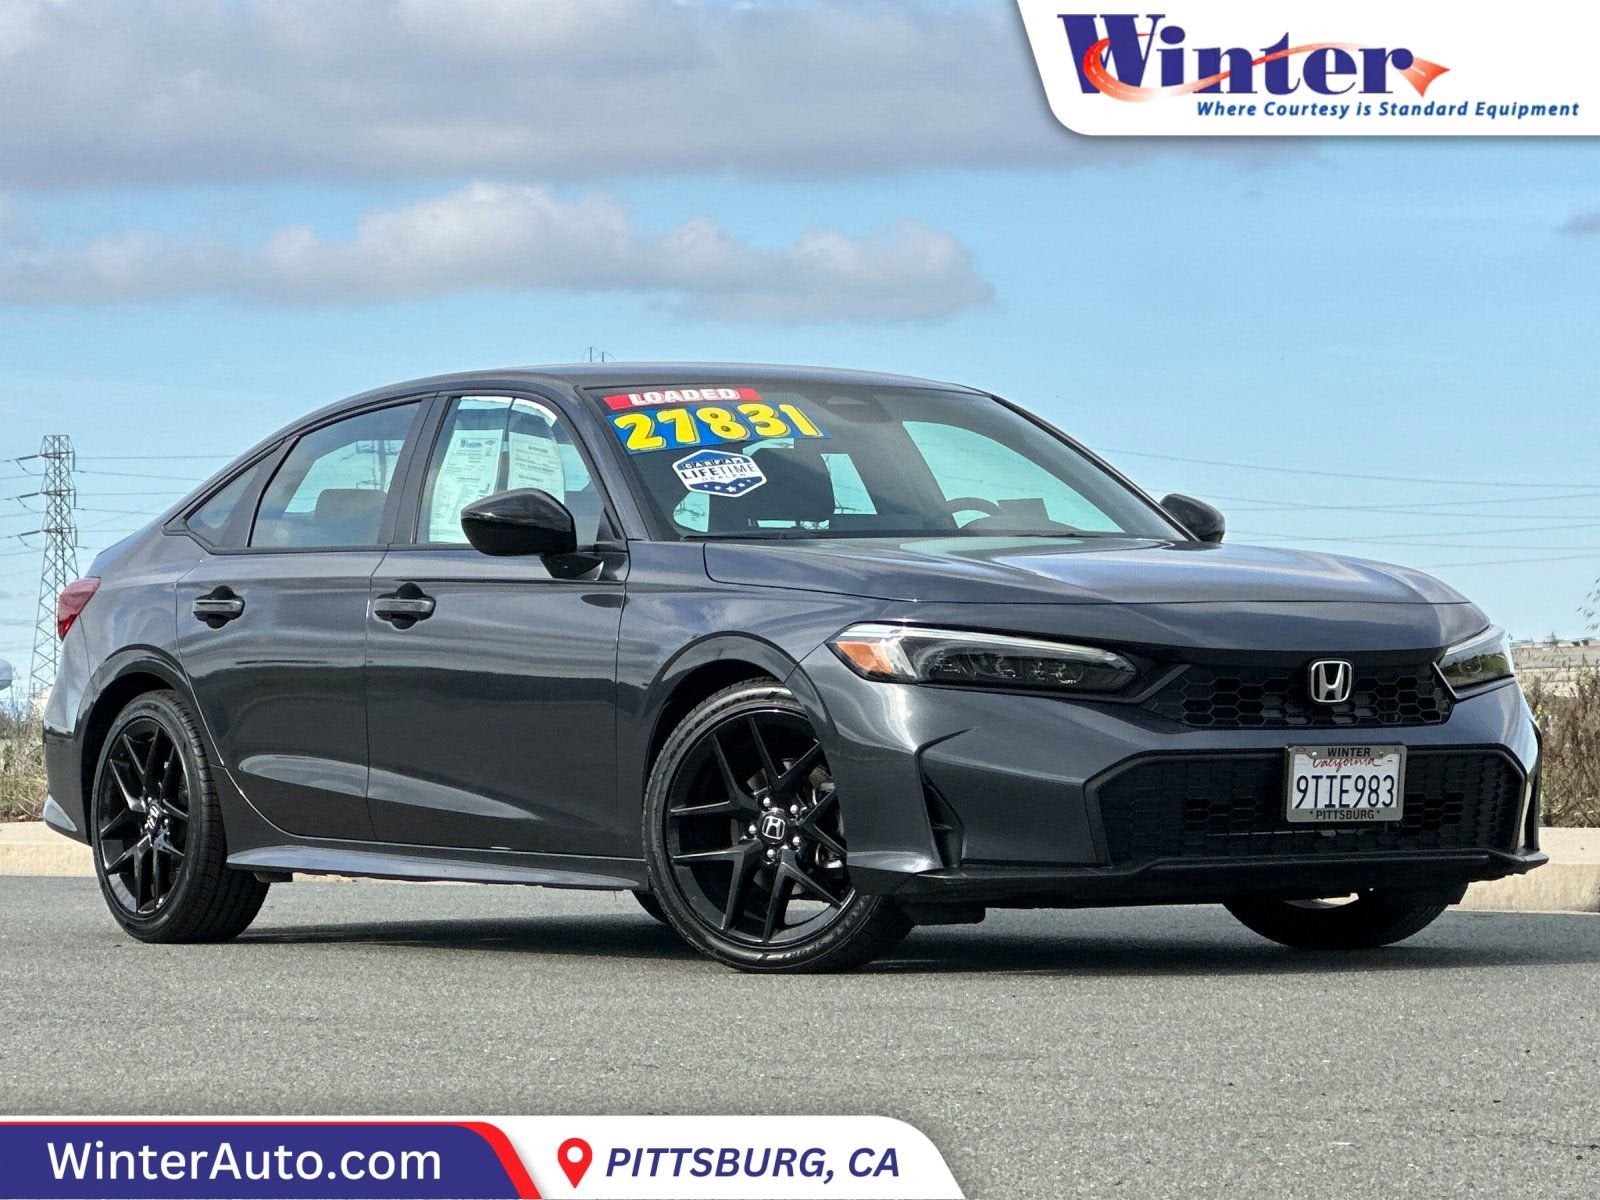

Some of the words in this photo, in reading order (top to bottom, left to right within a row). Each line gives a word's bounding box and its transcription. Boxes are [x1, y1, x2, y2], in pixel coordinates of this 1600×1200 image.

[628, 388, 739, 406] LOADED
[613, 403, 824, 451] 27831
[681, 463, 758, 479] LIFETIME
[1327, 747, 1371, 757] WINTER
[1295, 775, 1395, 809] 9TIE983
[1315, 809, 1375, 820] PITTSBURG
